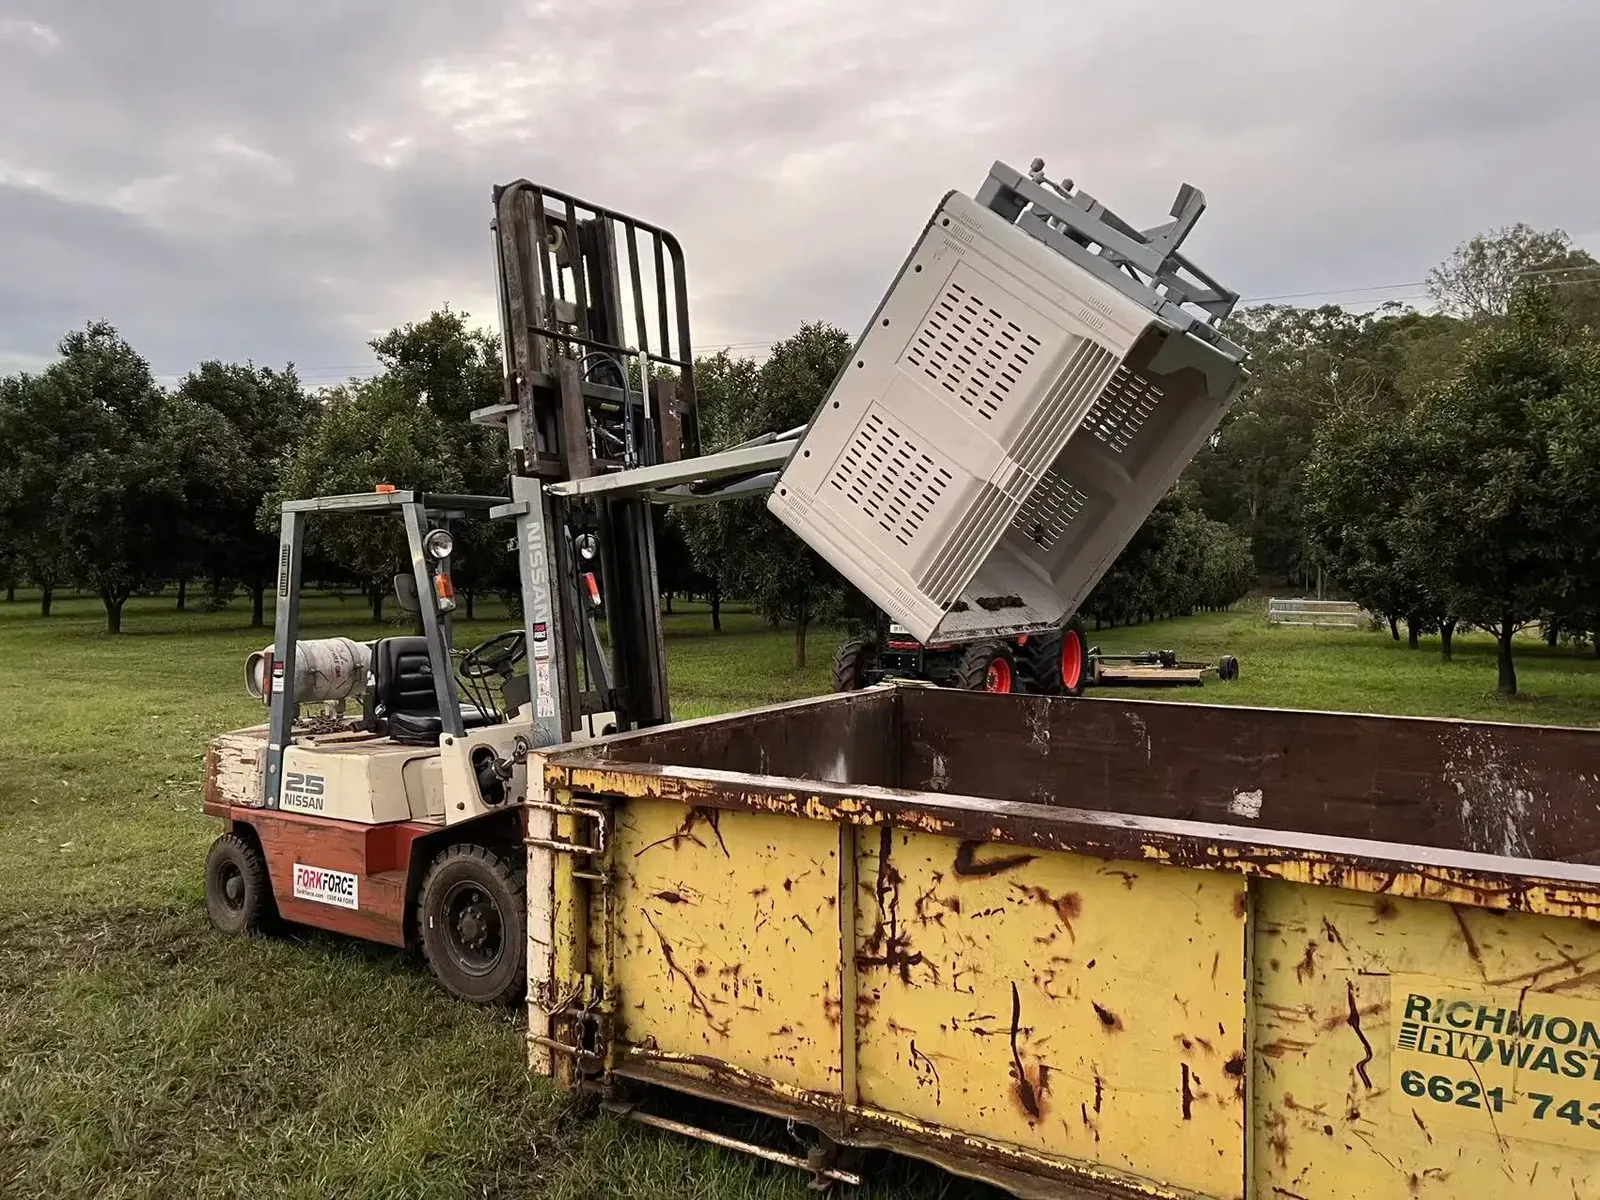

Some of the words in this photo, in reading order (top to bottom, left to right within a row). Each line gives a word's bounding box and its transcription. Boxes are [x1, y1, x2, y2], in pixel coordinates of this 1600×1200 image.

[527, 522, 549, 622] NISSAN
[286, 772, 324, 795] 25
[285, 793, 324, 810] NISSAN
[1400, 1070, 1504, 1113] 6621
